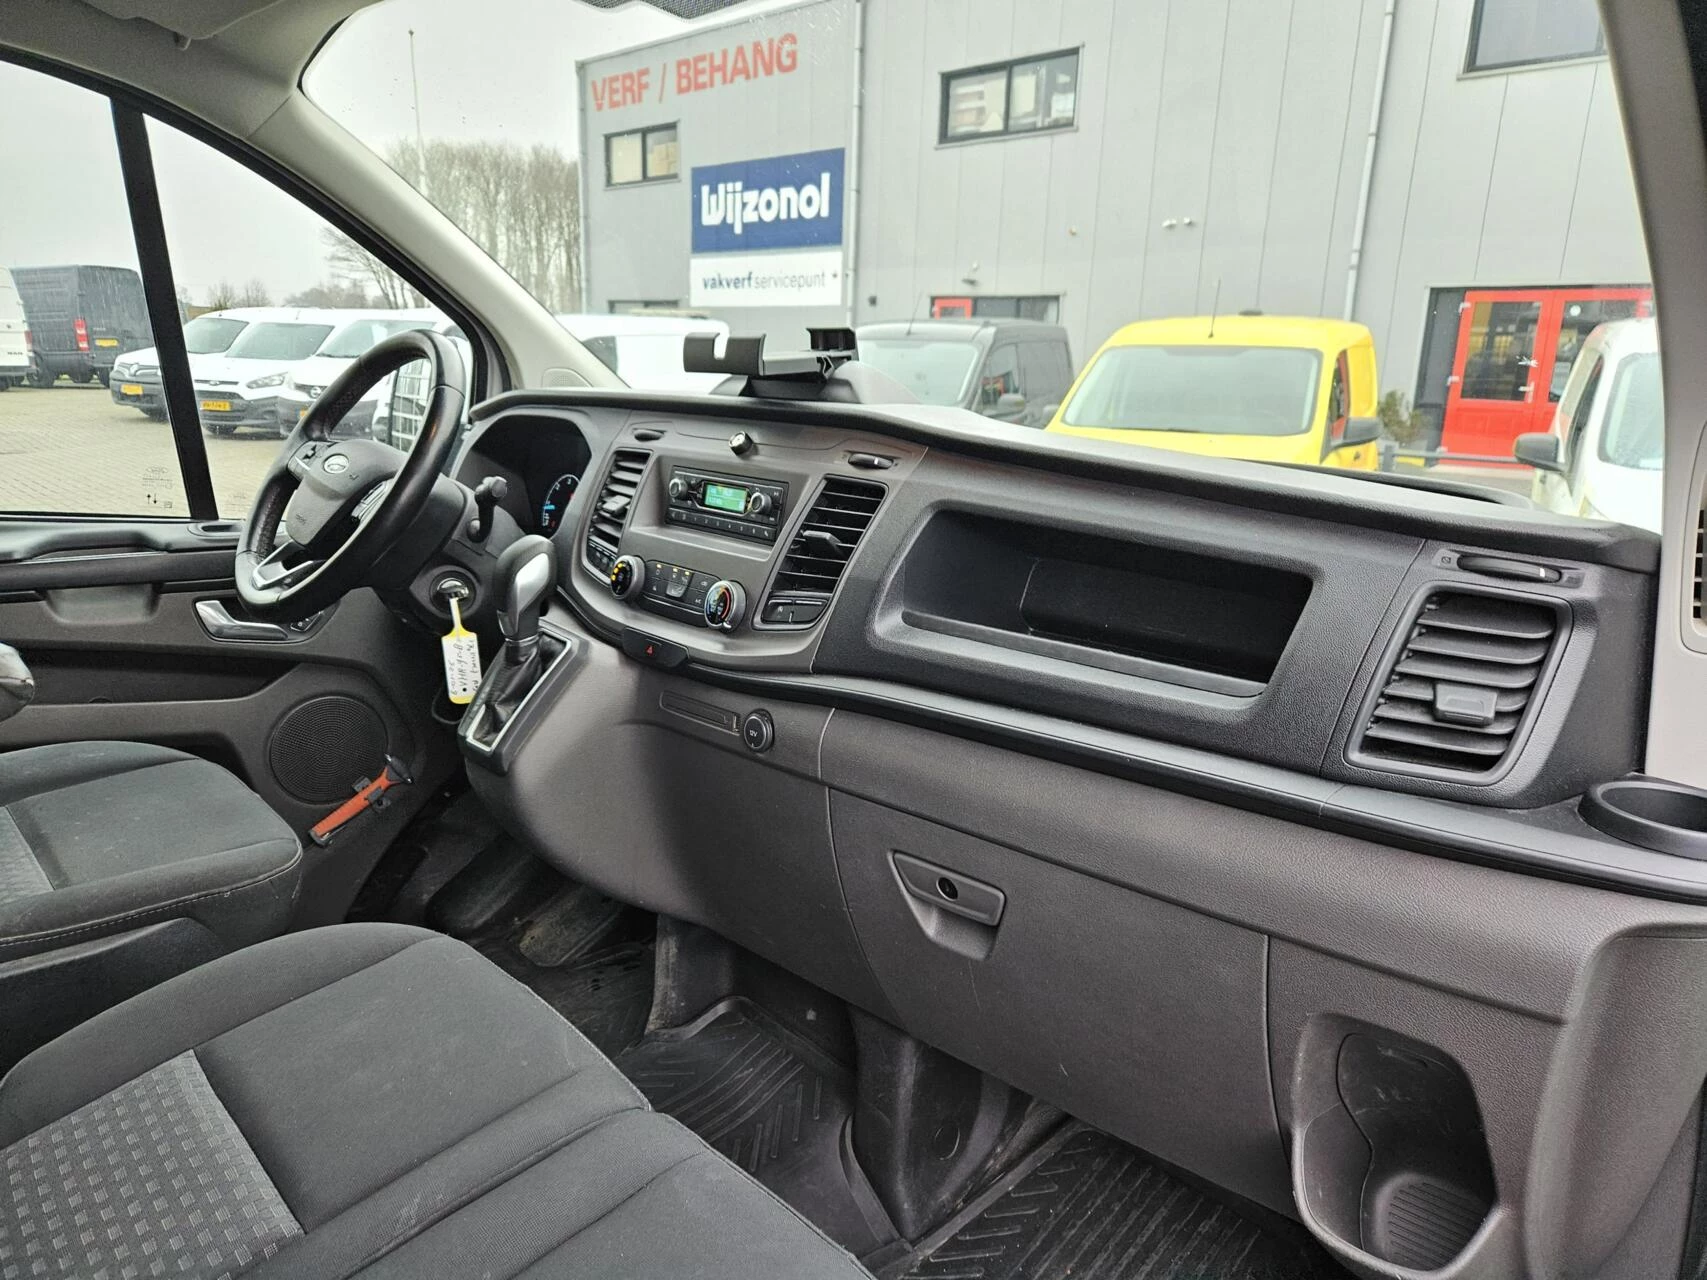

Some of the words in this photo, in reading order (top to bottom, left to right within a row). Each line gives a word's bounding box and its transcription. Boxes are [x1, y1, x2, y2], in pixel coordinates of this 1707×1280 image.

[591, 68, 650, 112] VERF
[676, 33, 798, 95] BEHANG
[701, 172, 831, 235] Wijzonol
